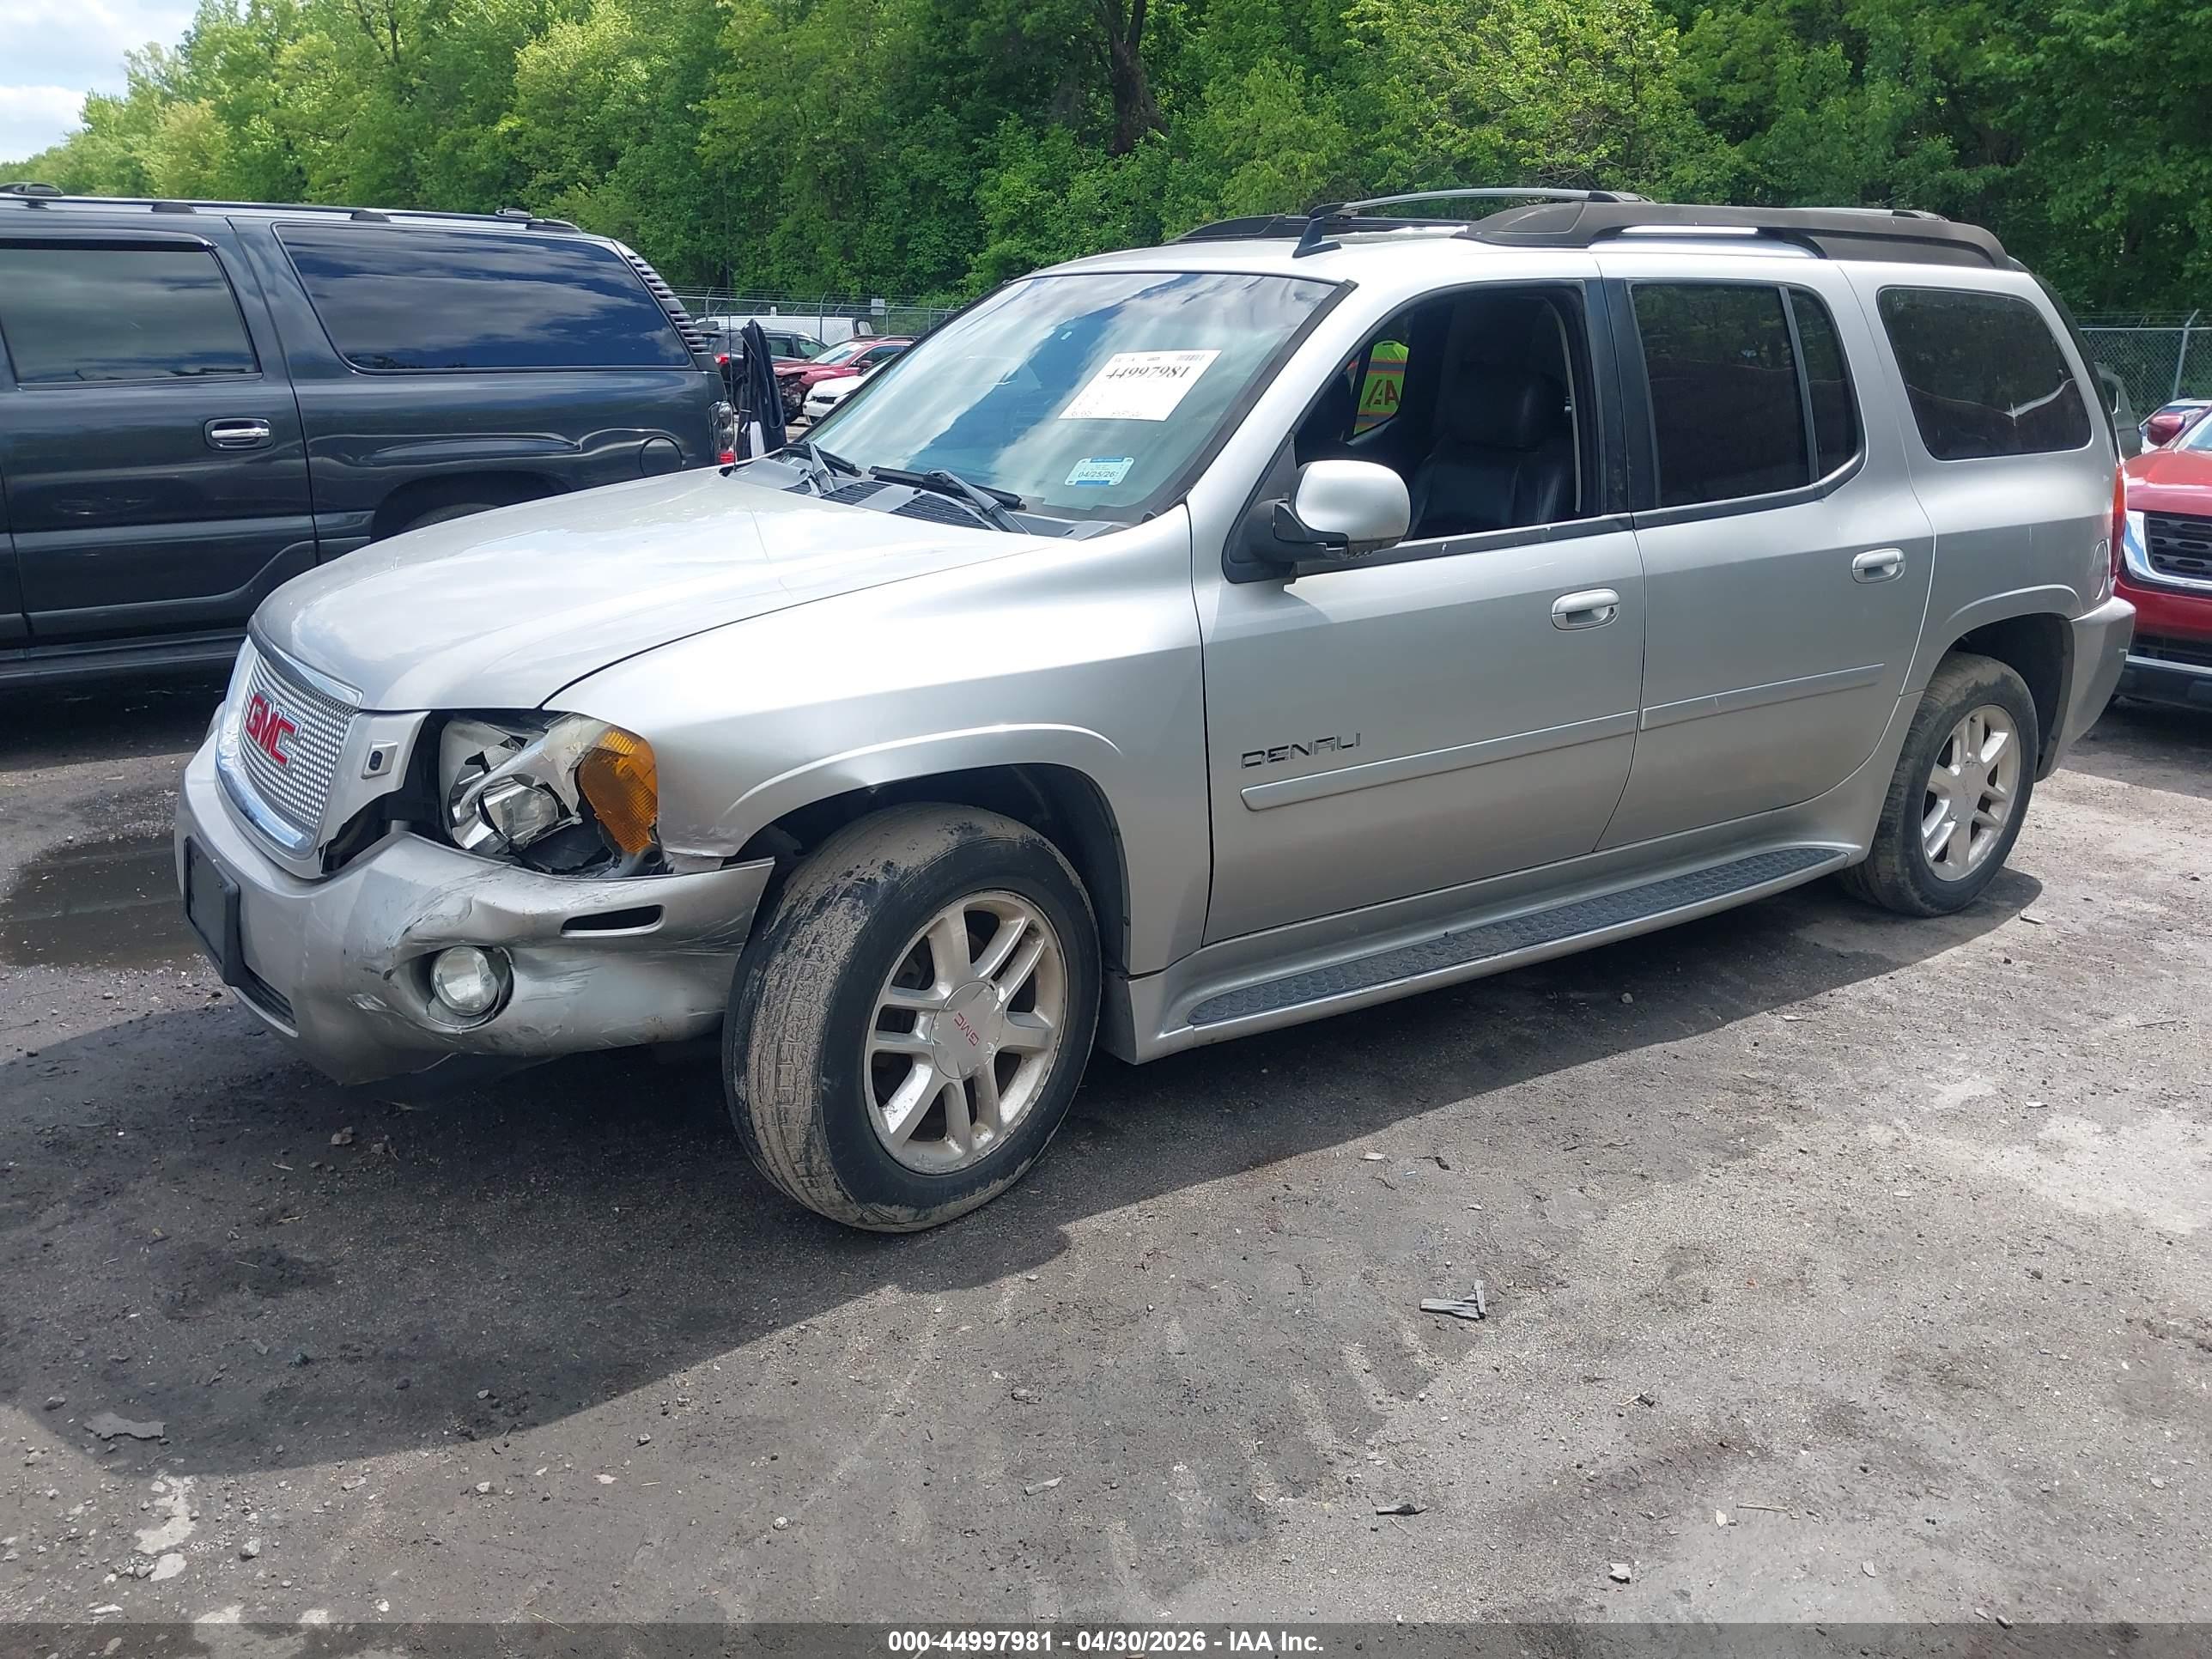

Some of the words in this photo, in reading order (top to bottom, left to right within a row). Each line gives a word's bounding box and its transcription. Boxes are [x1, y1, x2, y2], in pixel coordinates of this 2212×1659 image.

[1106, 365, 1191, 379] 44997981
[246, 691, 297, 766] GMC
[1241, 732, 1361, 769] DENALI
[954, 1012, 980, 1047] GMC
